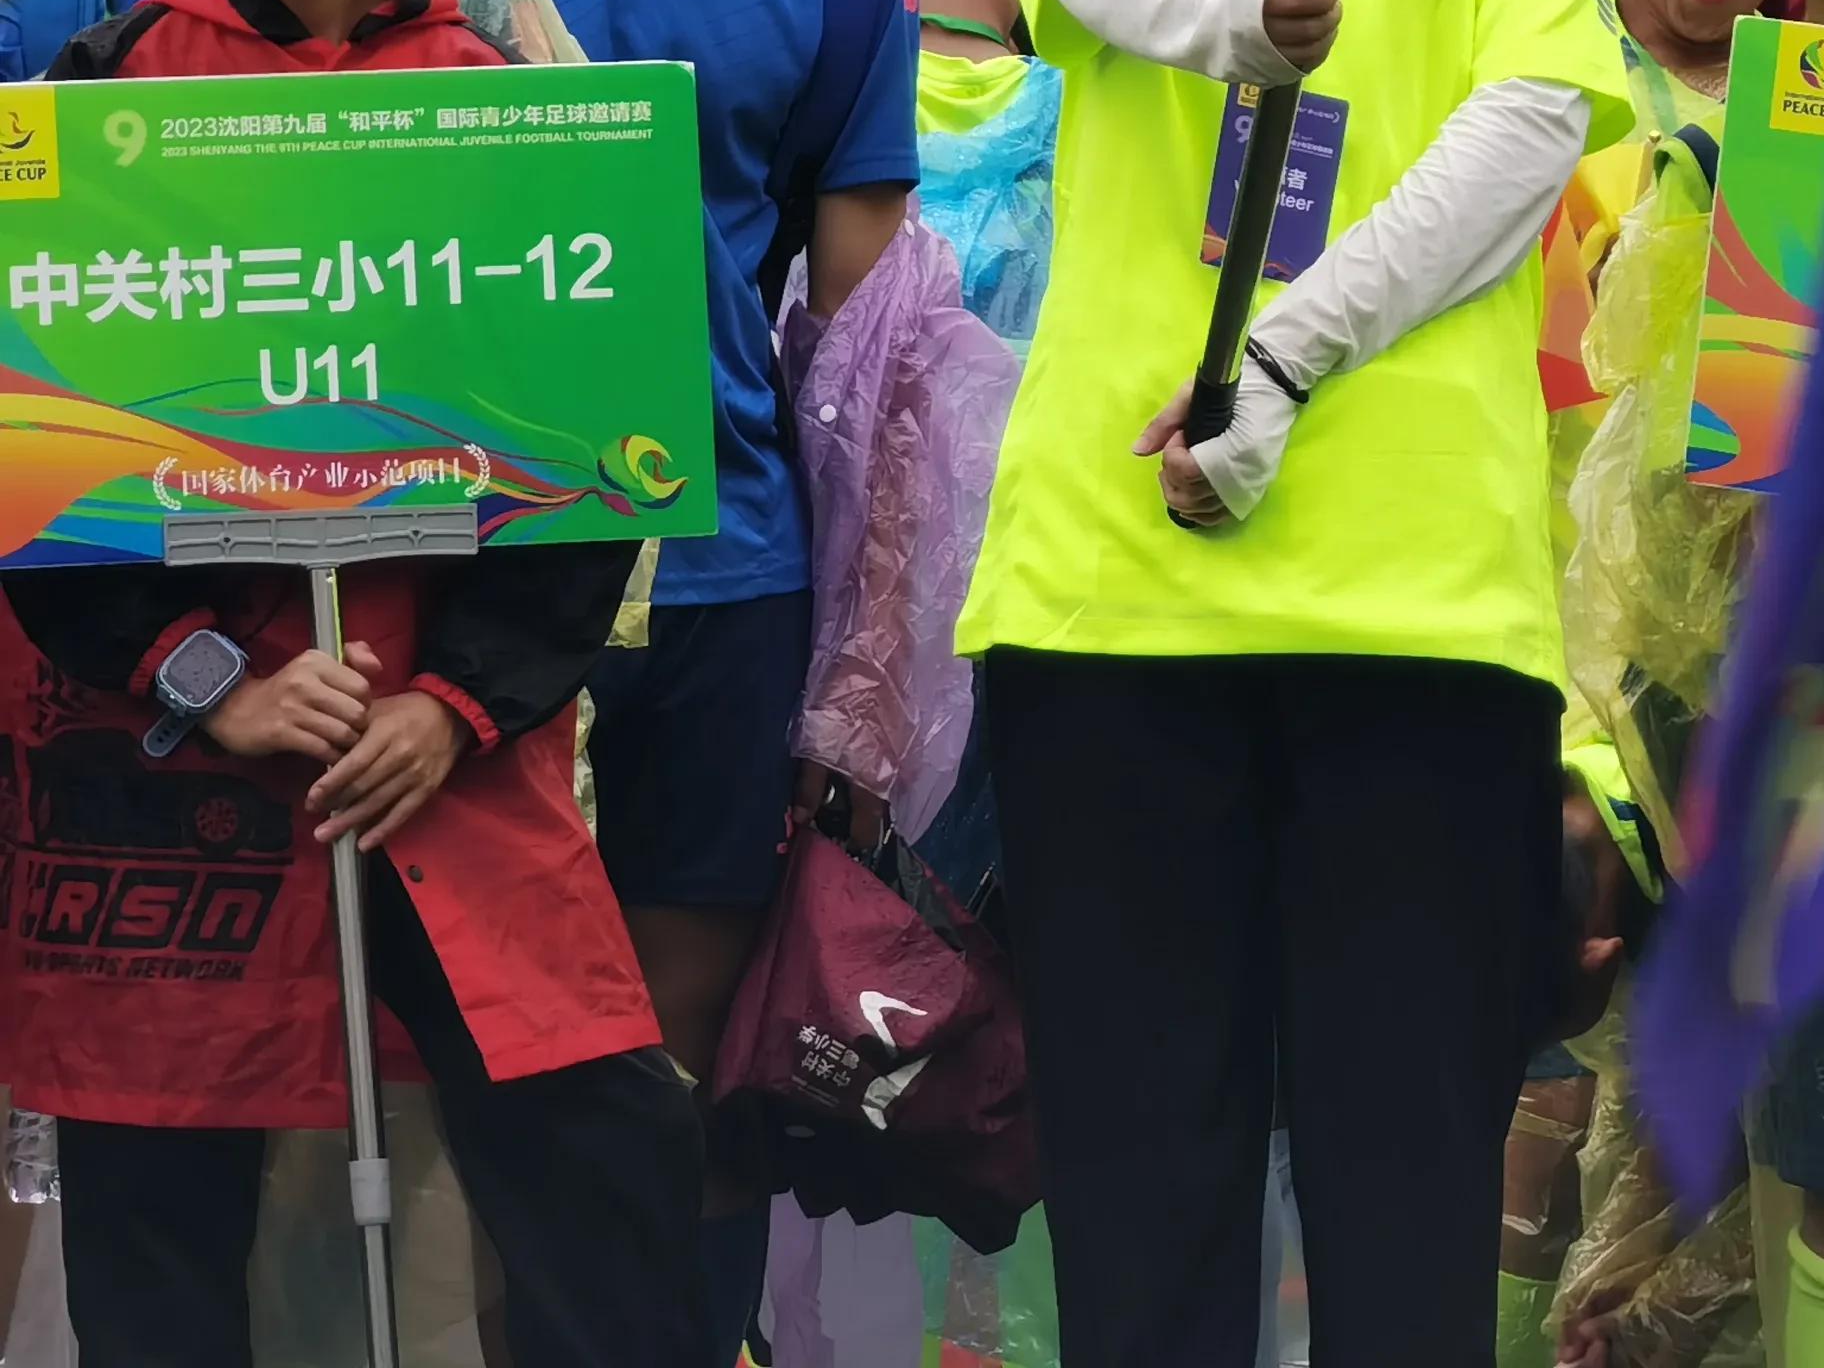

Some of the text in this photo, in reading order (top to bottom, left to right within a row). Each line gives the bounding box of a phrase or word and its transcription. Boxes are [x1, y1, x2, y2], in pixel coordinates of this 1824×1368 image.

[103, 110, 148, 168] 9
[189, 144, 252, 156] SHENYANG
[255, 143, 277, 153] THE
[302, 140, 340, 151] PEACE
[343, 139, 365, 150] CUP
[515, 132, 573, 144] FOOTBALL
[16, 167, 47, 181] CUP
[259, 342, 379, 406] U11
